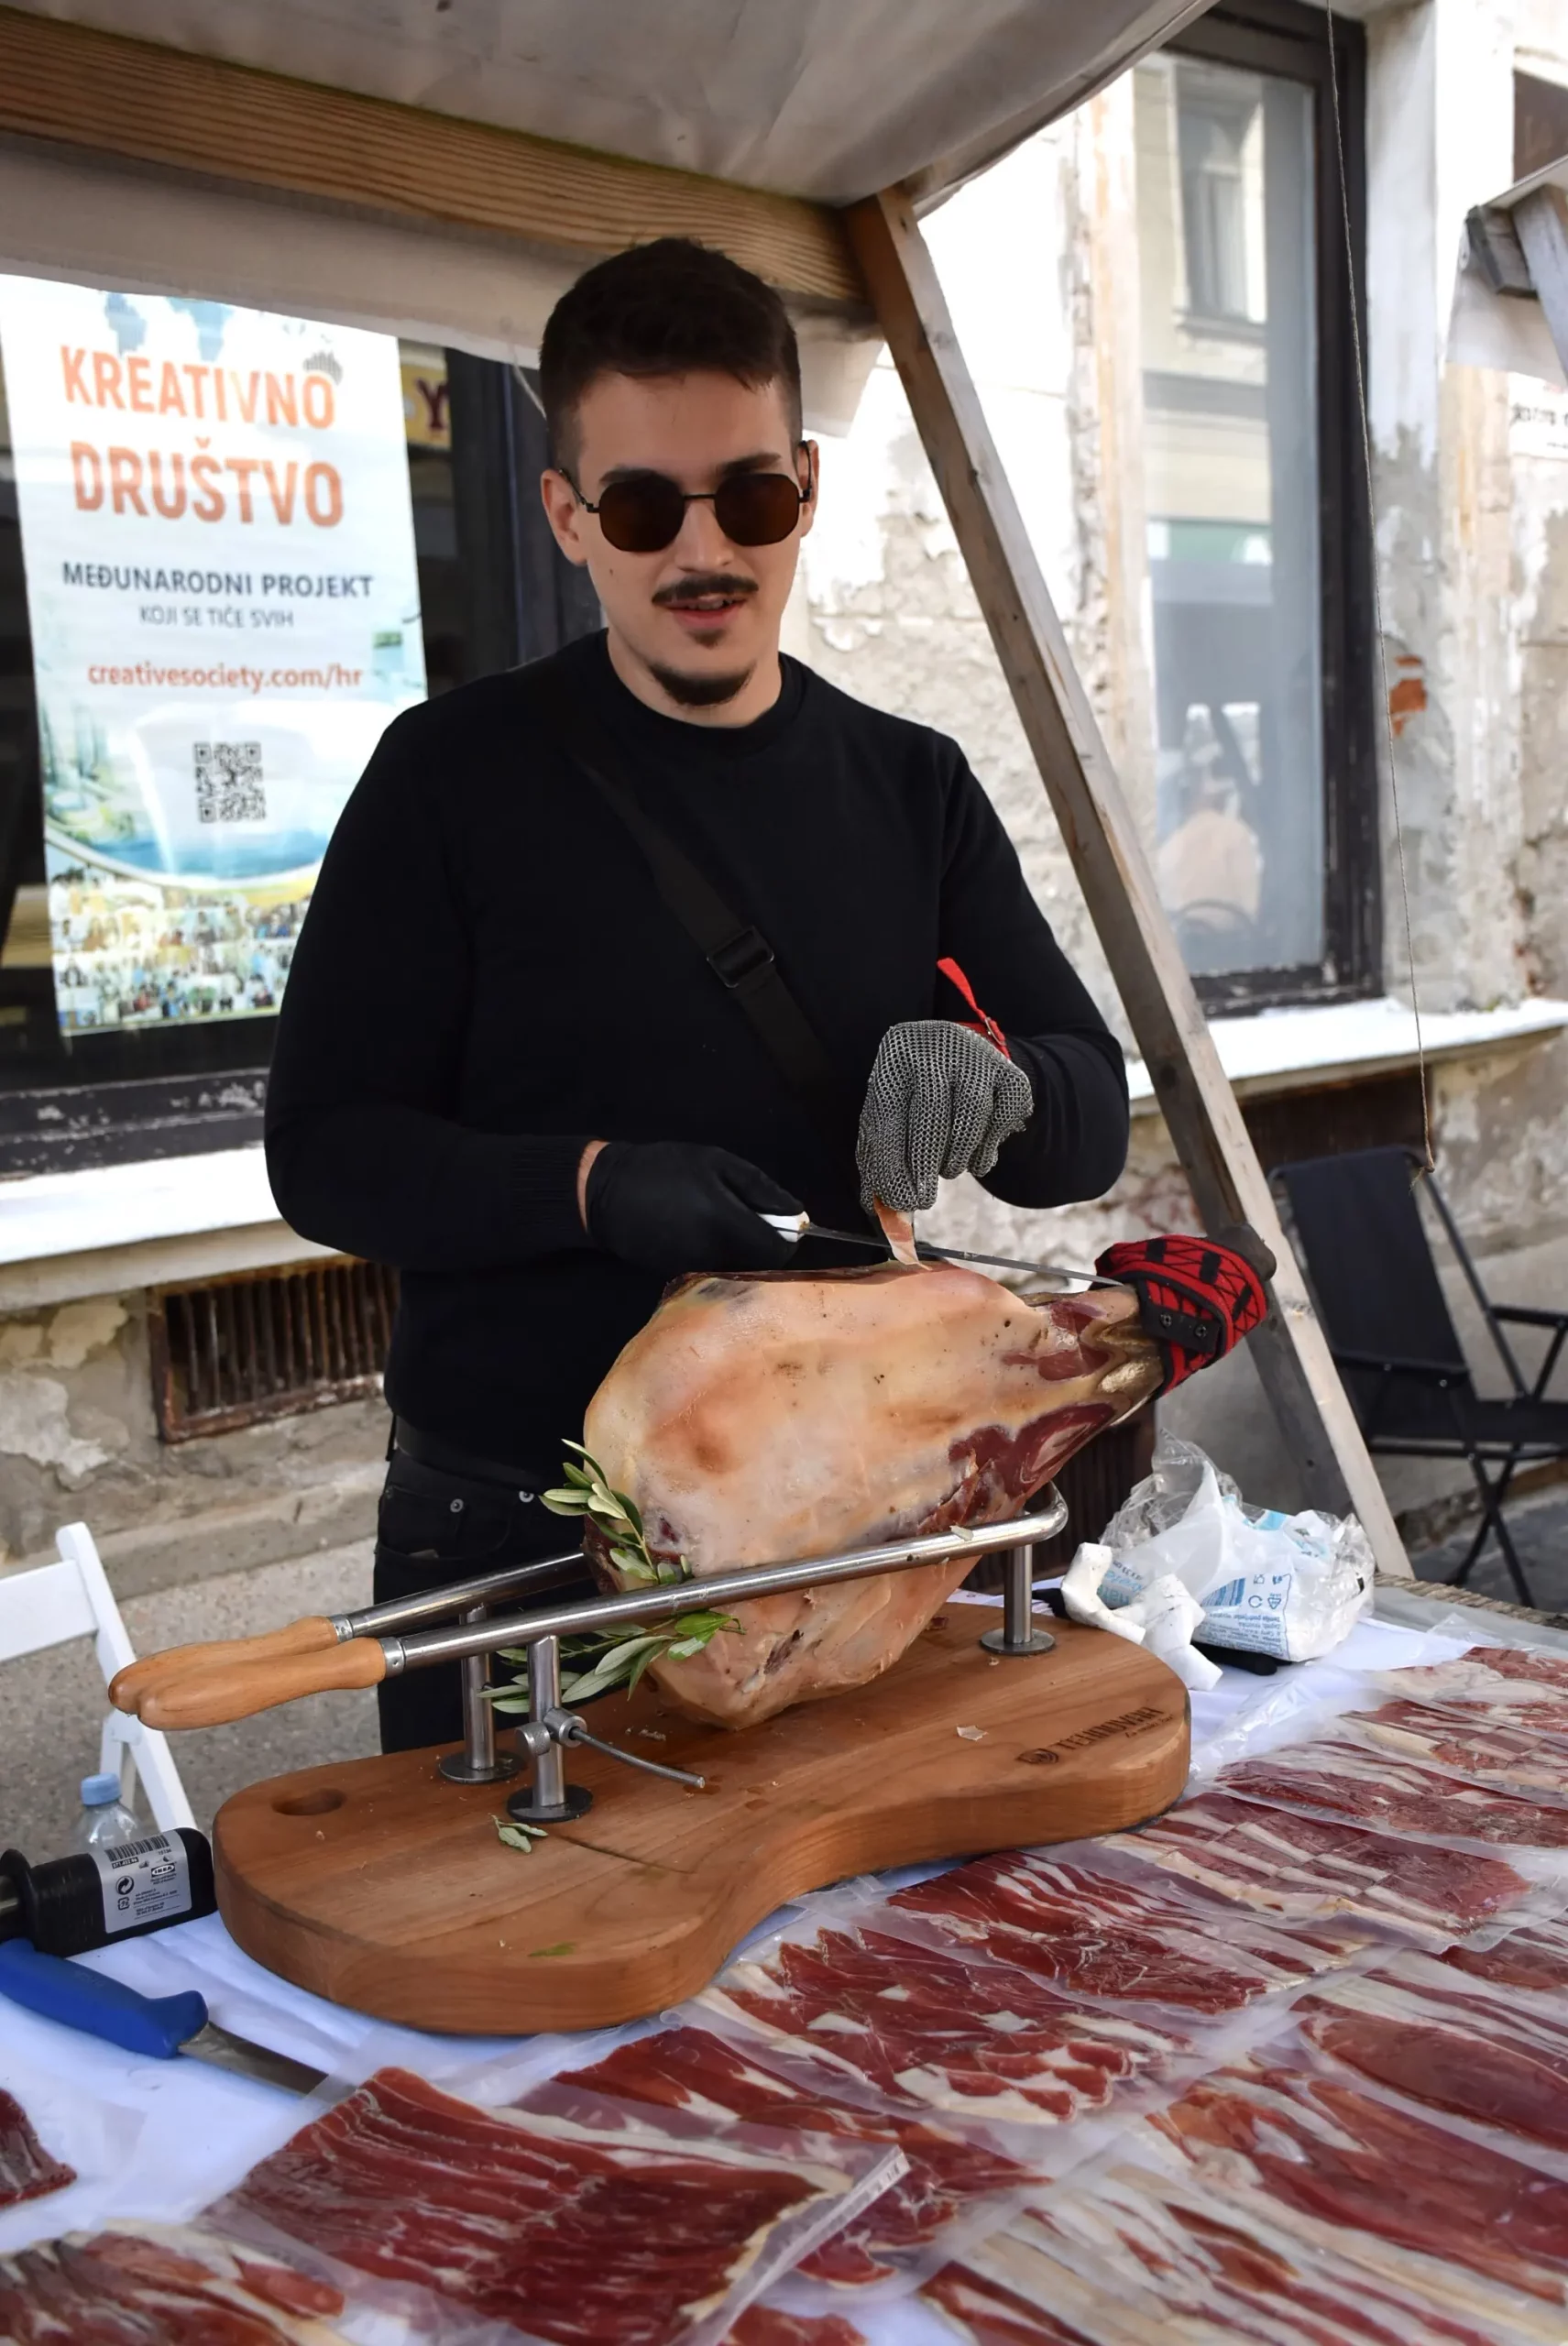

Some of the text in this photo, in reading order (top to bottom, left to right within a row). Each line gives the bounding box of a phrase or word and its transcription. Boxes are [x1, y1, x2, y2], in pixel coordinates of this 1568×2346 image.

[60, 345, 335, 430] KREATIVNO
[70, 436, 345, 529] DRUŠTVO
[62, 561, 374, 597] MEĐUNARODNI PROJEKT
[139, 605, 178, 626] KOJI
[183, 606, 202, 627] SE
[249, 608, 294, 630] SVIH
[88, 661, 364, 694] creativesociety.com/hr
[154, 1865, 173, 1874] IKEA
